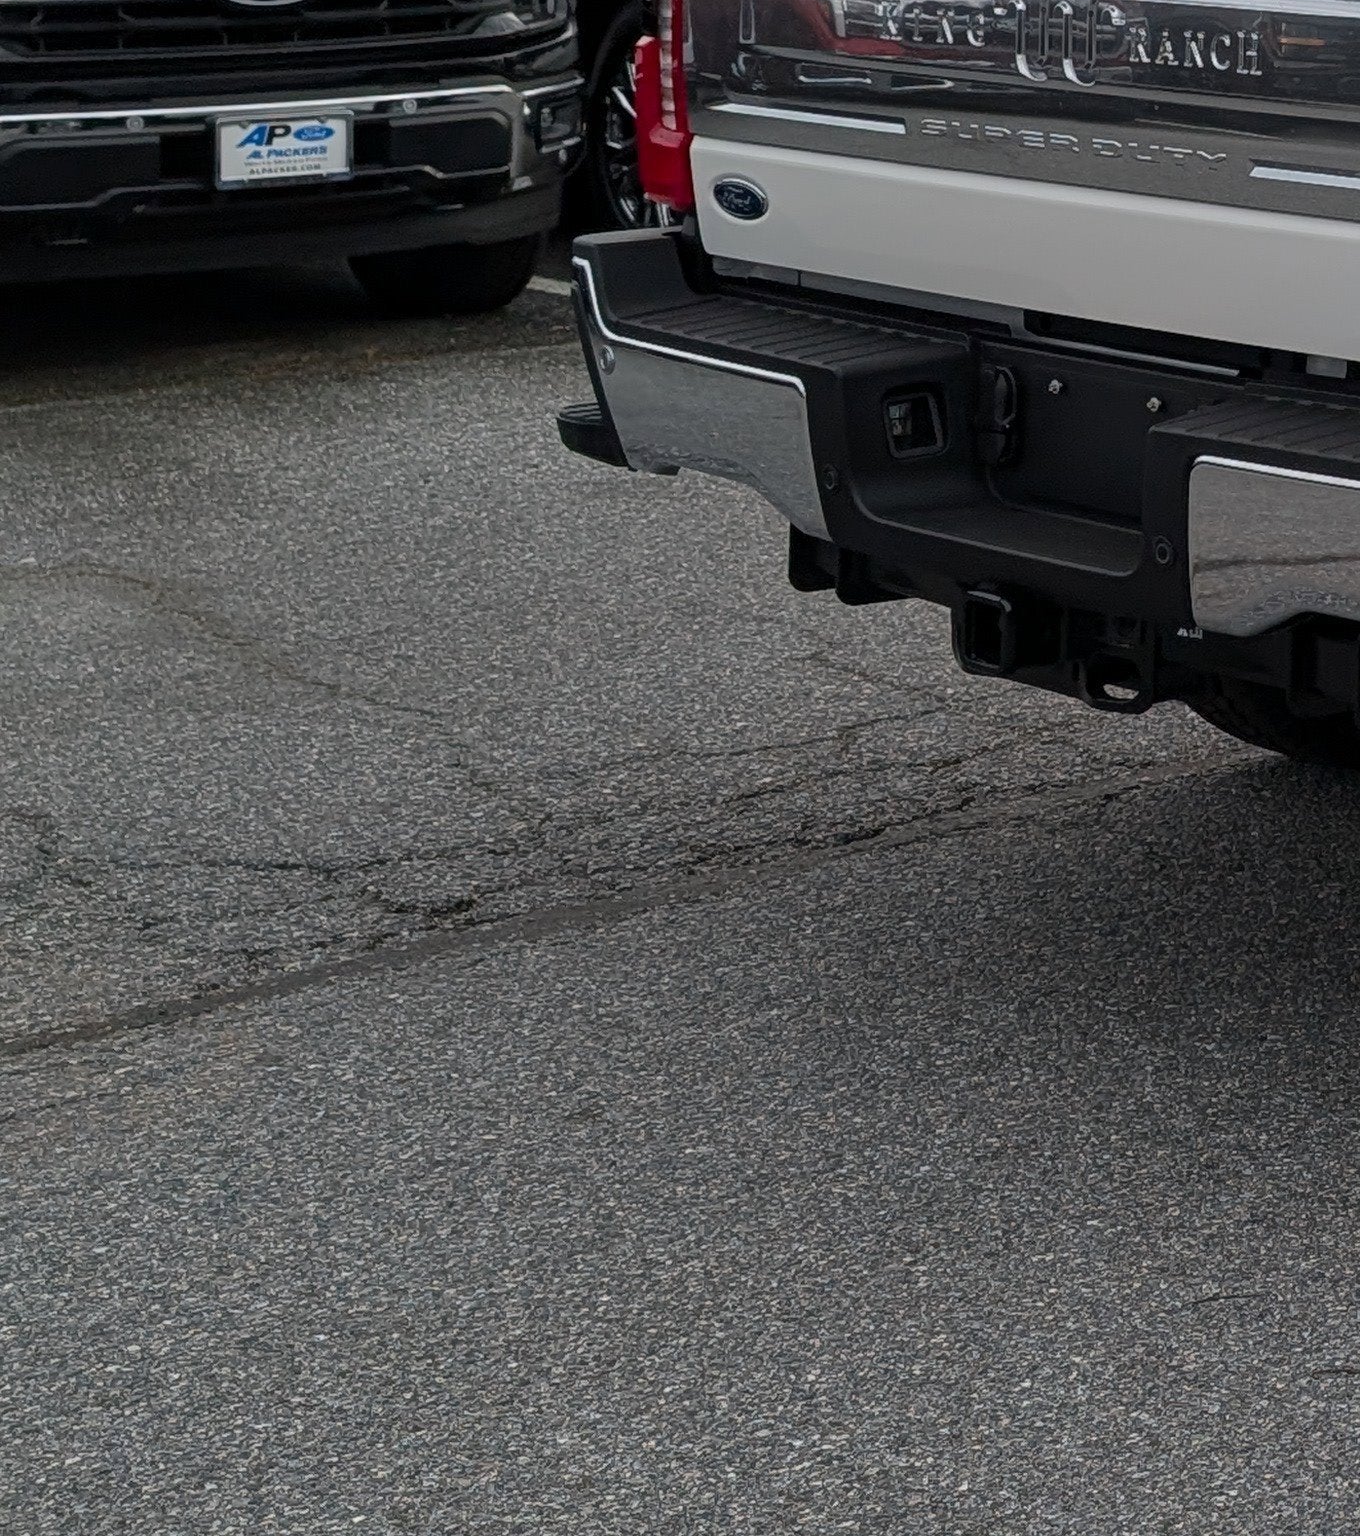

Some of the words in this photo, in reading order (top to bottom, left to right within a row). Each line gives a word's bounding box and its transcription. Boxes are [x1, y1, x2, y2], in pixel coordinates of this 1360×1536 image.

[876, 0, 987, 48] KING
[1128, 25, 1263, 75] RANCH
[237, 125, 292, 148] AP
[920, 117, 1080, 153] SUPER
[1091, 137, 1228, 170] DUTY
